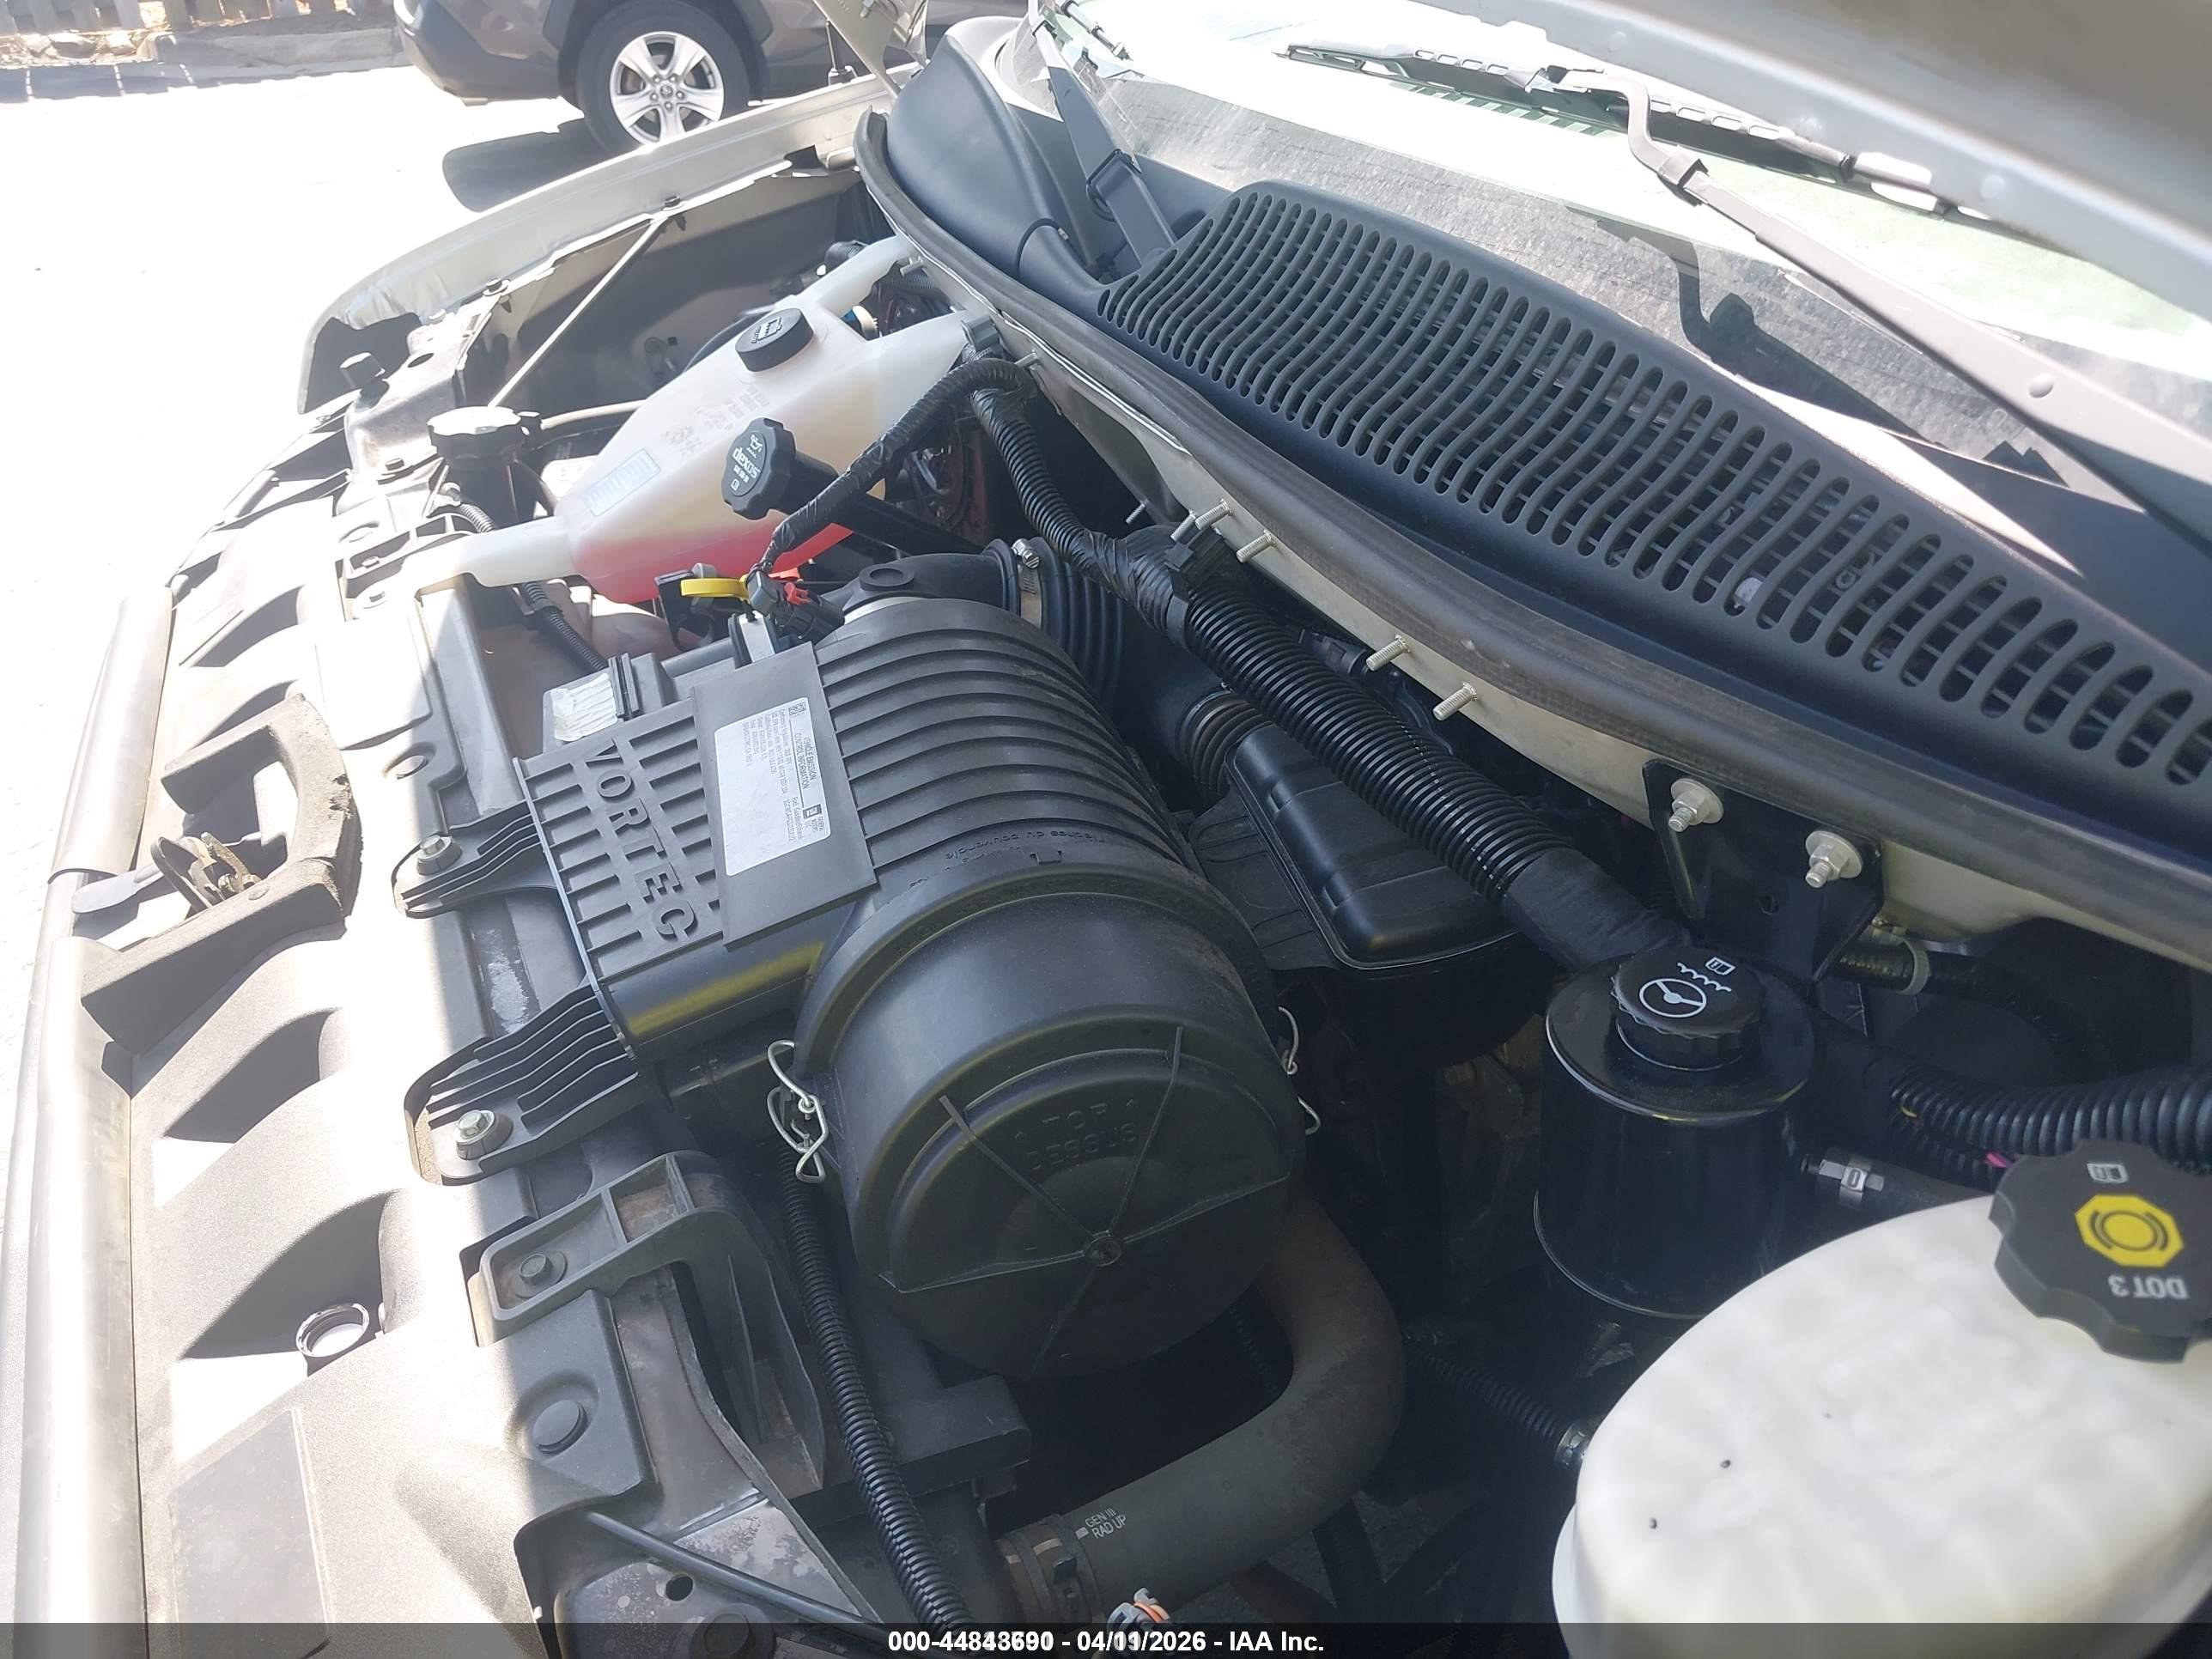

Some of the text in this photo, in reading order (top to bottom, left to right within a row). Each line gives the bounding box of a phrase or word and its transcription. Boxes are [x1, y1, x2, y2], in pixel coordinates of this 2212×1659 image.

[732, 447, 761, 478] dexos
[794, 732, 810, 790] CONTROL INFORMATION
[806, 755, 817, 781] EMISSION
[585, 738, 698, 939] VORTEC
[1042, 1103, 1107, 1134] TOP
[2107, 1274, 2189, 1299] DOT 3
[1085, 1512, 1107, 1528] GEN
[1092, 1514, 1127, 1539] RAD UP
